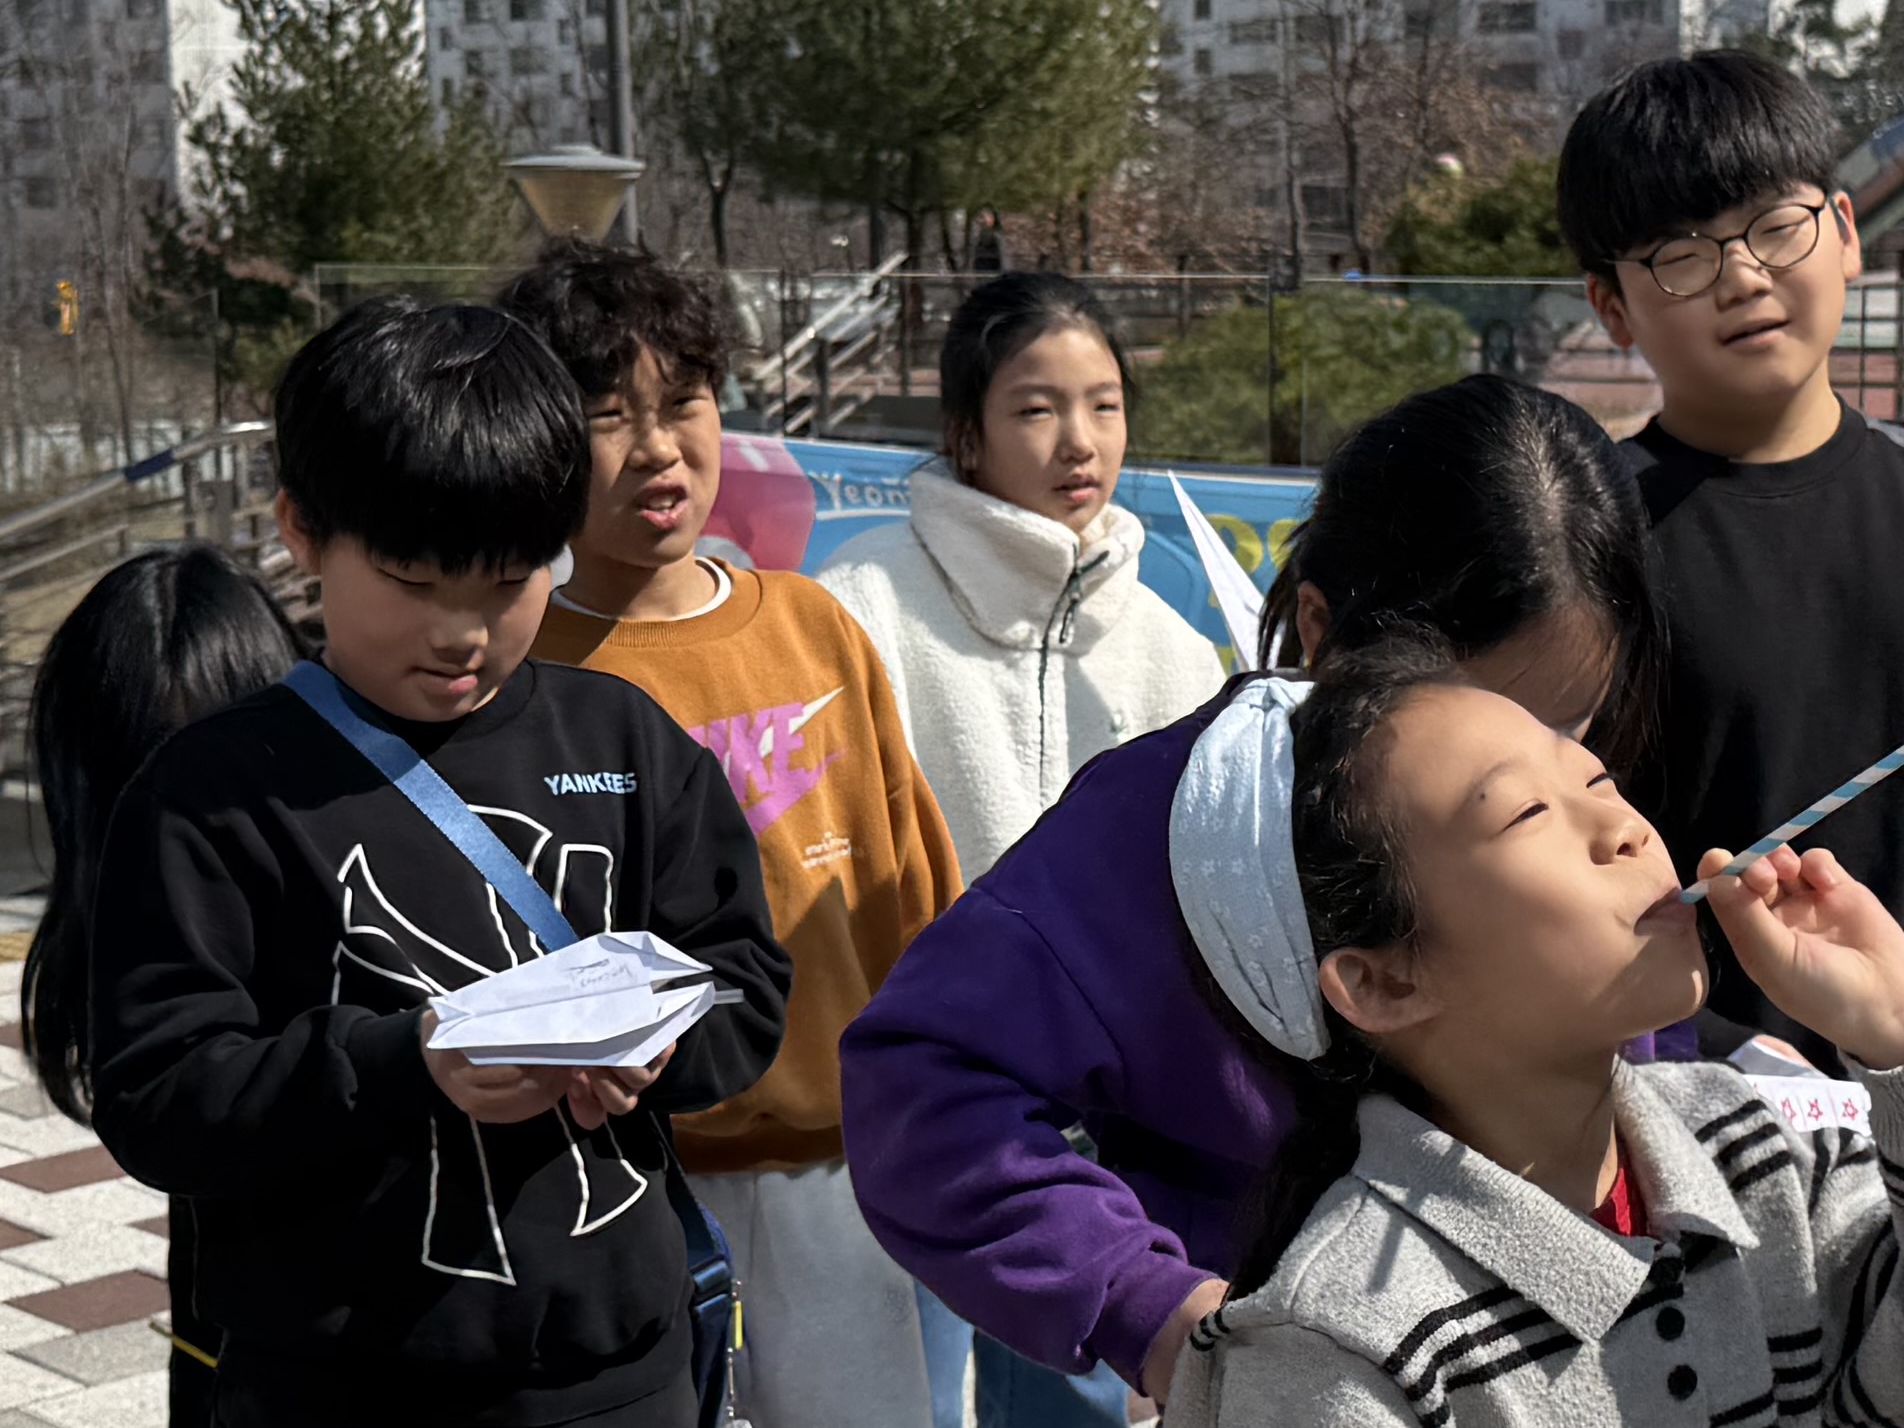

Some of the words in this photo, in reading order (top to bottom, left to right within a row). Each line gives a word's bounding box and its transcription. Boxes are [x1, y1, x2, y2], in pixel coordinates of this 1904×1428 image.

[807, 470, 912, 514] Yeon
[687, 702, 809, 804] IKE
[543, 772, 637, 796] YANKEES
